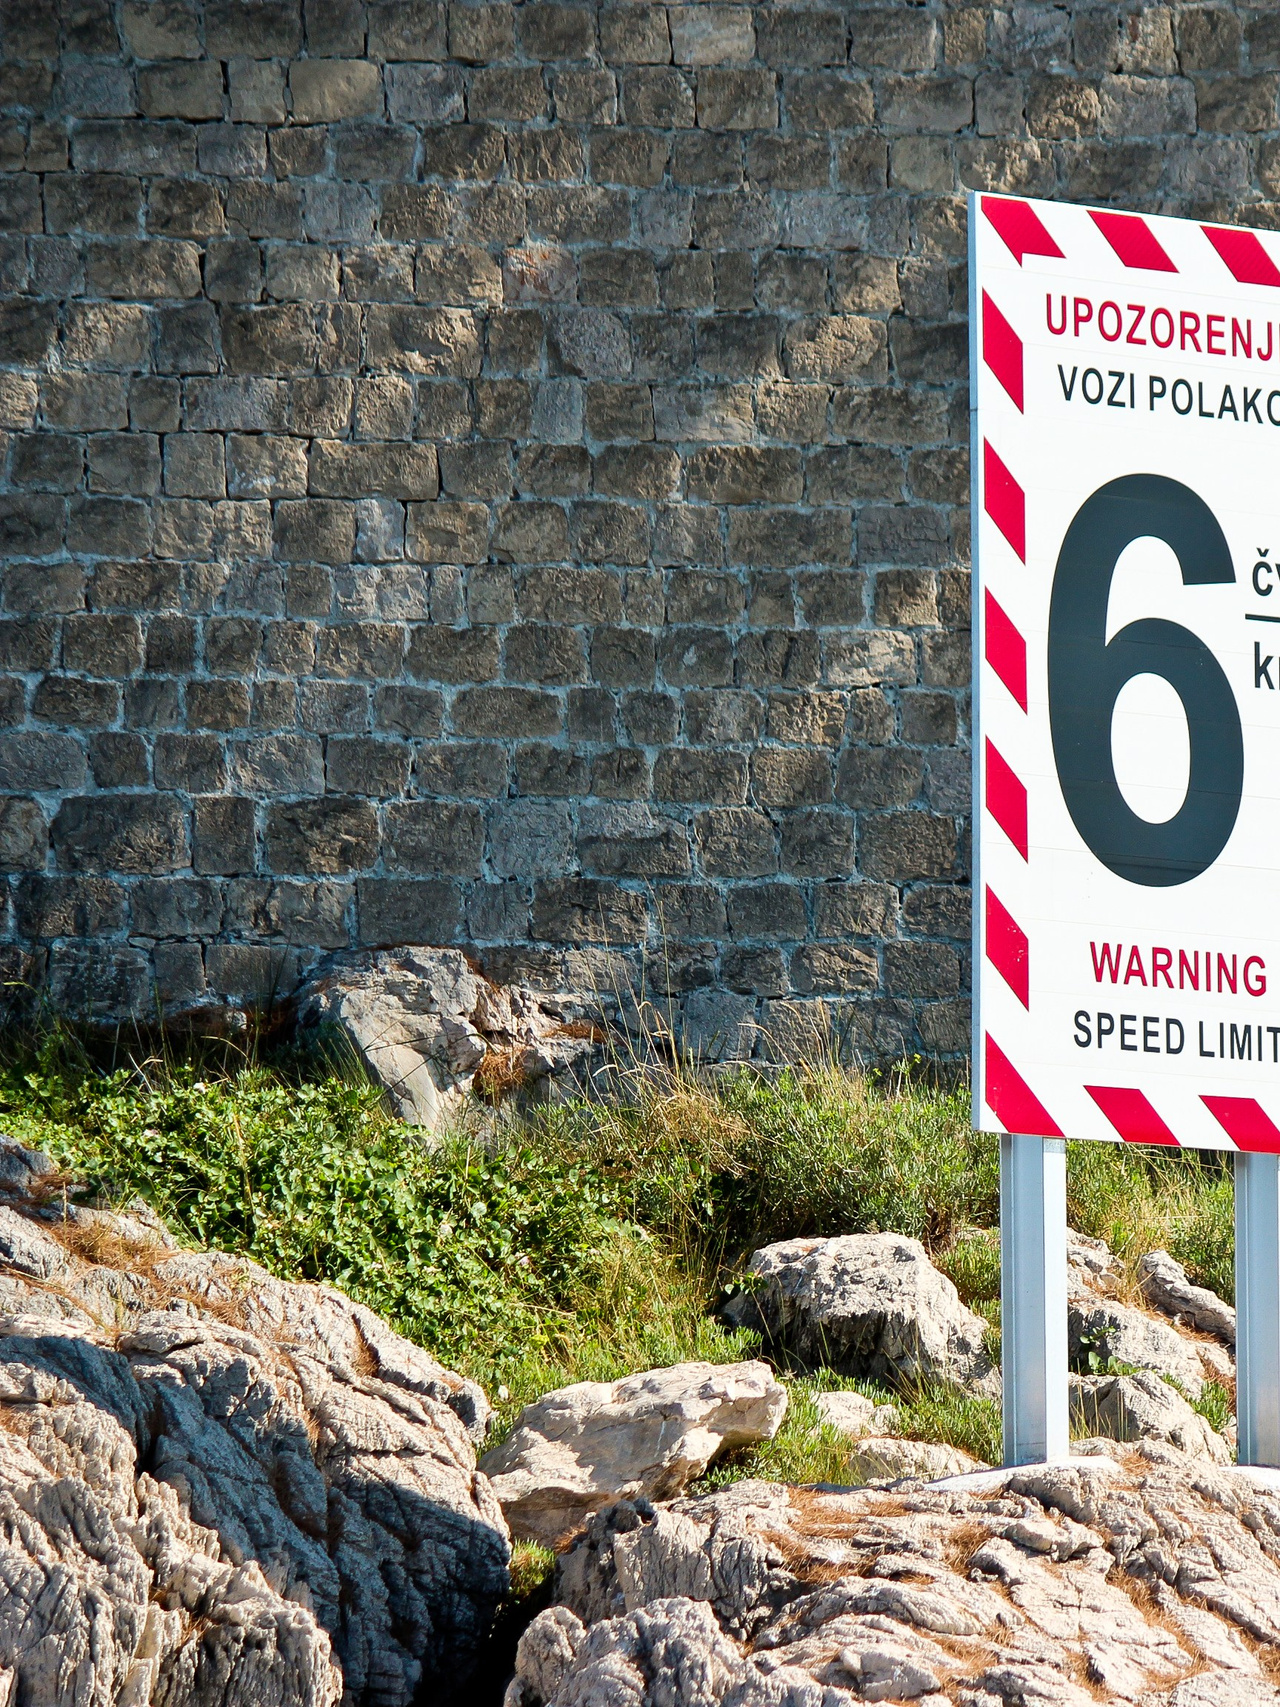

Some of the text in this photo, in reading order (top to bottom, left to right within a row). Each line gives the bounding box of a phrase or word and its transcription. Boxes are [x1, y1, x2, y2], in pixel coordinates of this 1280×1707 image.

[1057, 363, 1136, 410] VOZI
[1047, 472, 1246, 888] 6
[1089, 940, 1268, 998] WARNING
[1072, 1008, 1186, 1056] SPEED
